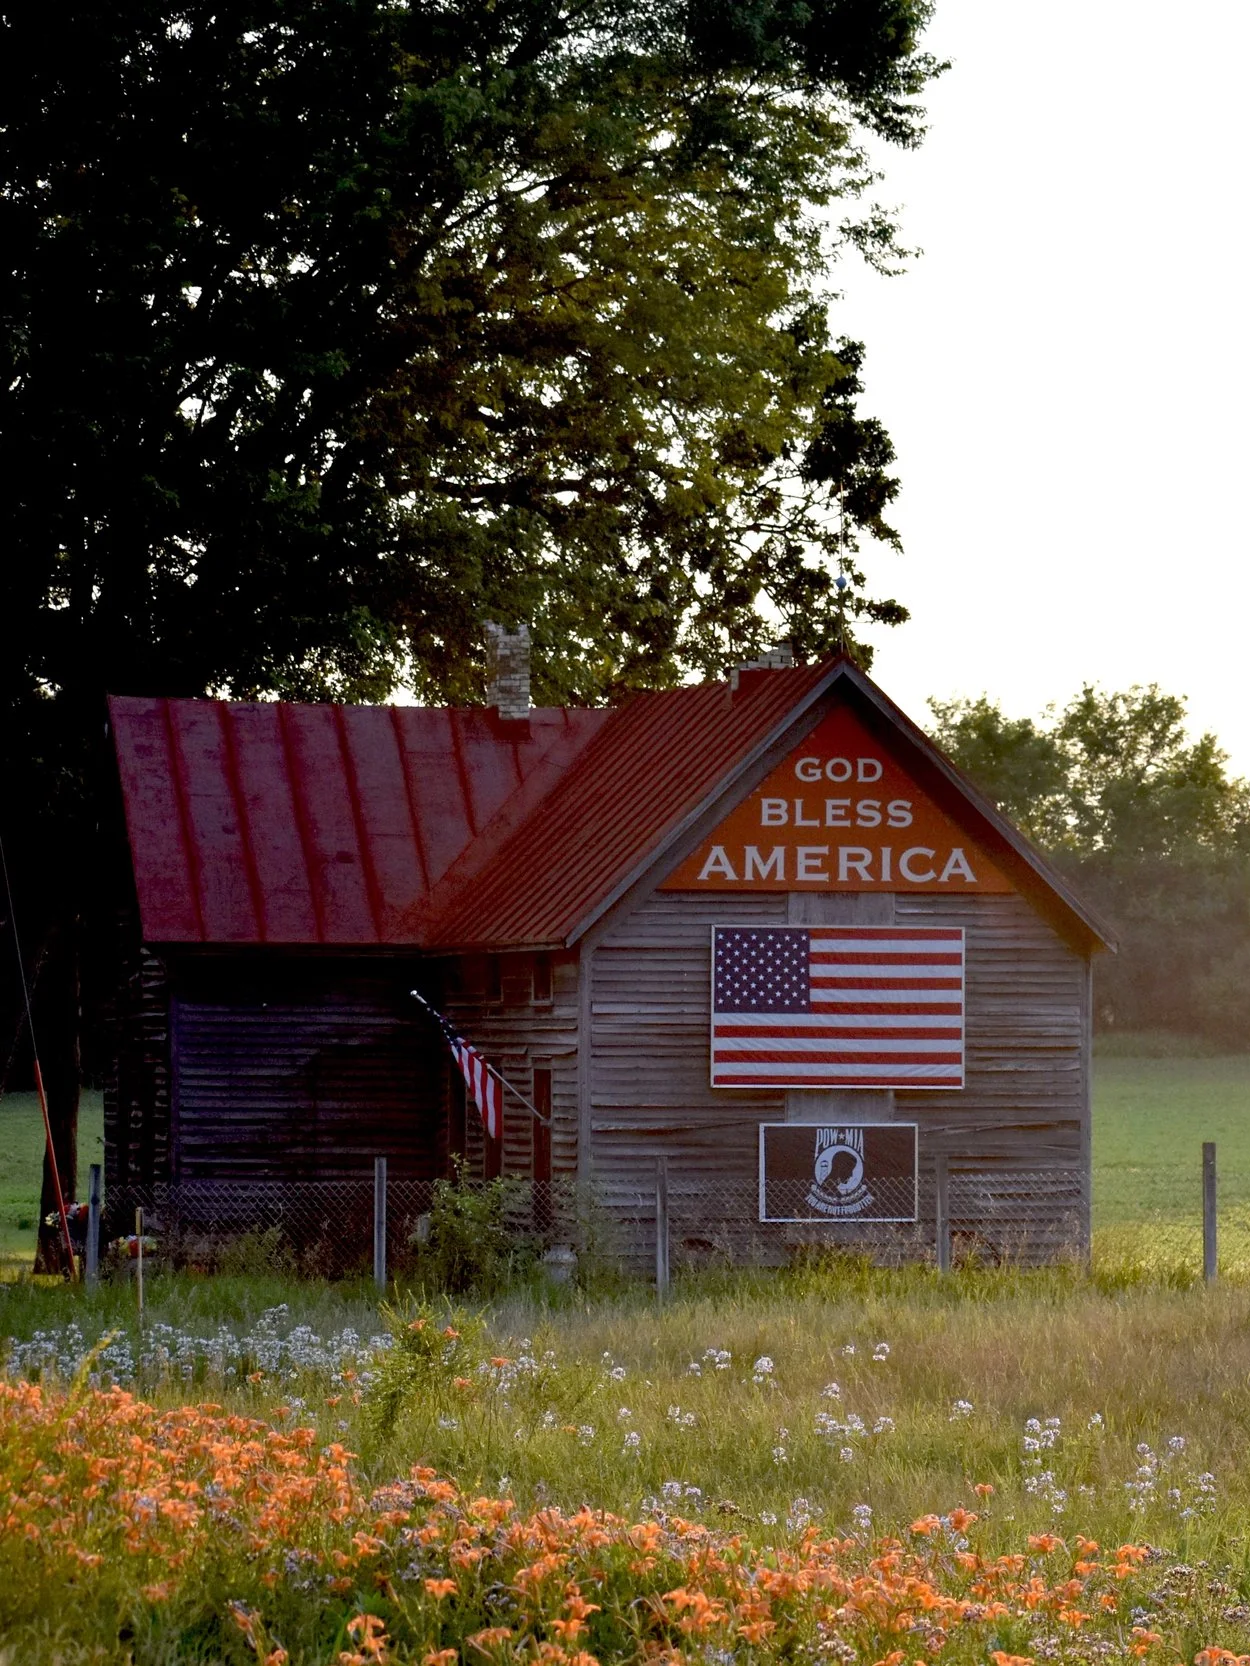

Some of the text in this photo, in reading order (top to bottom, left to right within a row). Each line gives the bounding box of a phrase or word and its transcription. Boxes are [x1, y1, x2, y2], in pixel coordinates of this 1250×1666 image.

[795, 757, 883, 783] GOD
[760, 797, 913, 828] BLESS
[696, 845, 979, 883] AMERICA
[814, 1129, 865, 1161] POW MIA
